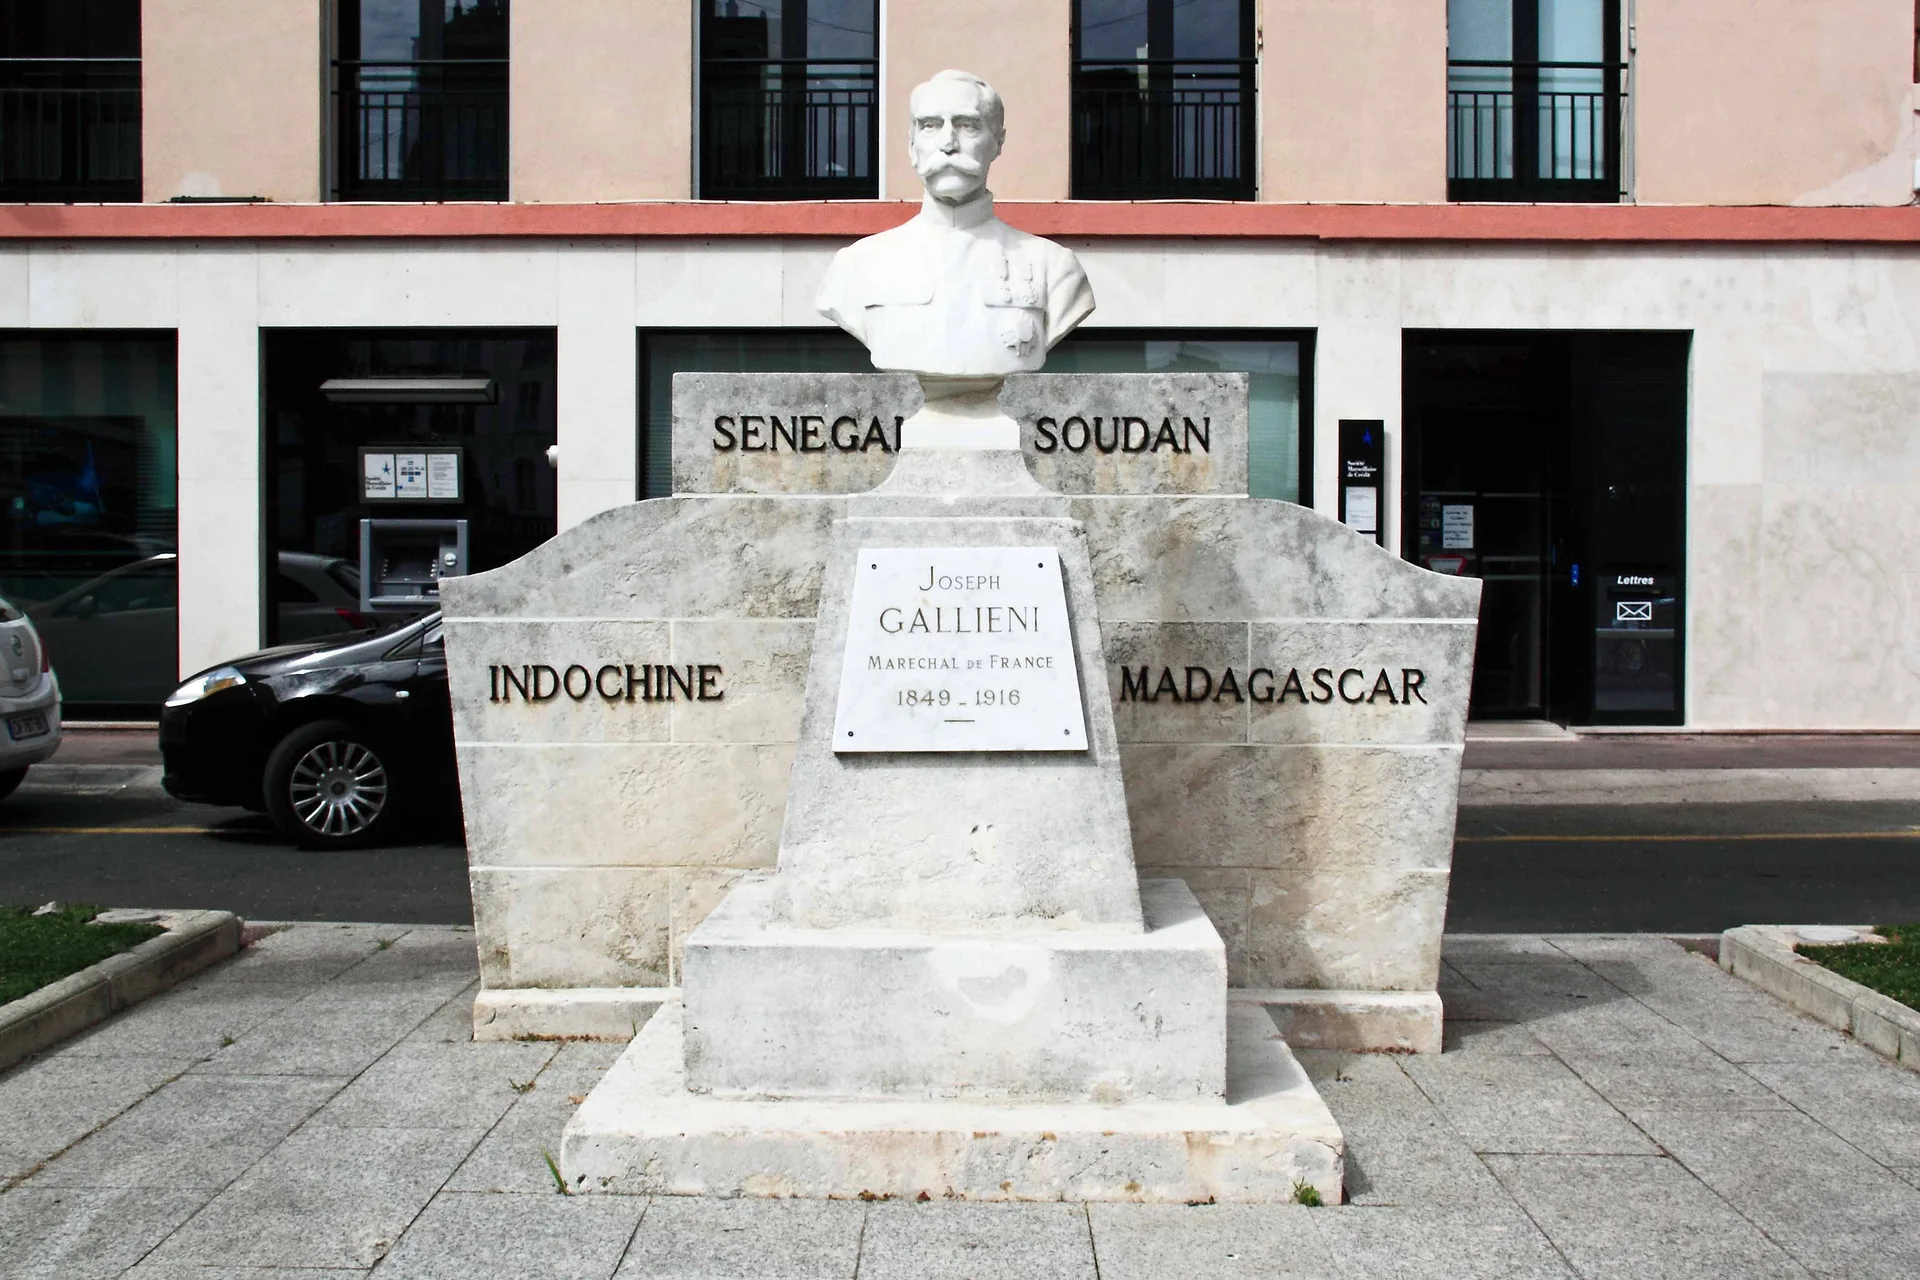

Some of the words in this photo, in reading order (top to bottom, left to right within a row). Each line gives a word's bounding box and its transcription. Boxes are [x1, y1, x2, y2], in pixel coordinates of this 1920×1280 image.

[1034, 416, 1211, 454] SOUDAN
[919, 566, 1000, 591] JOSEPH
[1617, 575, 1654, 585] Lettres
[879, 606, 1039, 633] GALLIENI
[868, 656, 959, 670] MARECHAL
[990, 655, 1053, 669] FRANCE
[489, 664, 724, 702] INDOCHINE
[1119, 665, 1428, 705] MADAGASCAR
[898, 689, 951, 706] 1849
[975, 689, 1020, 706] 1916
